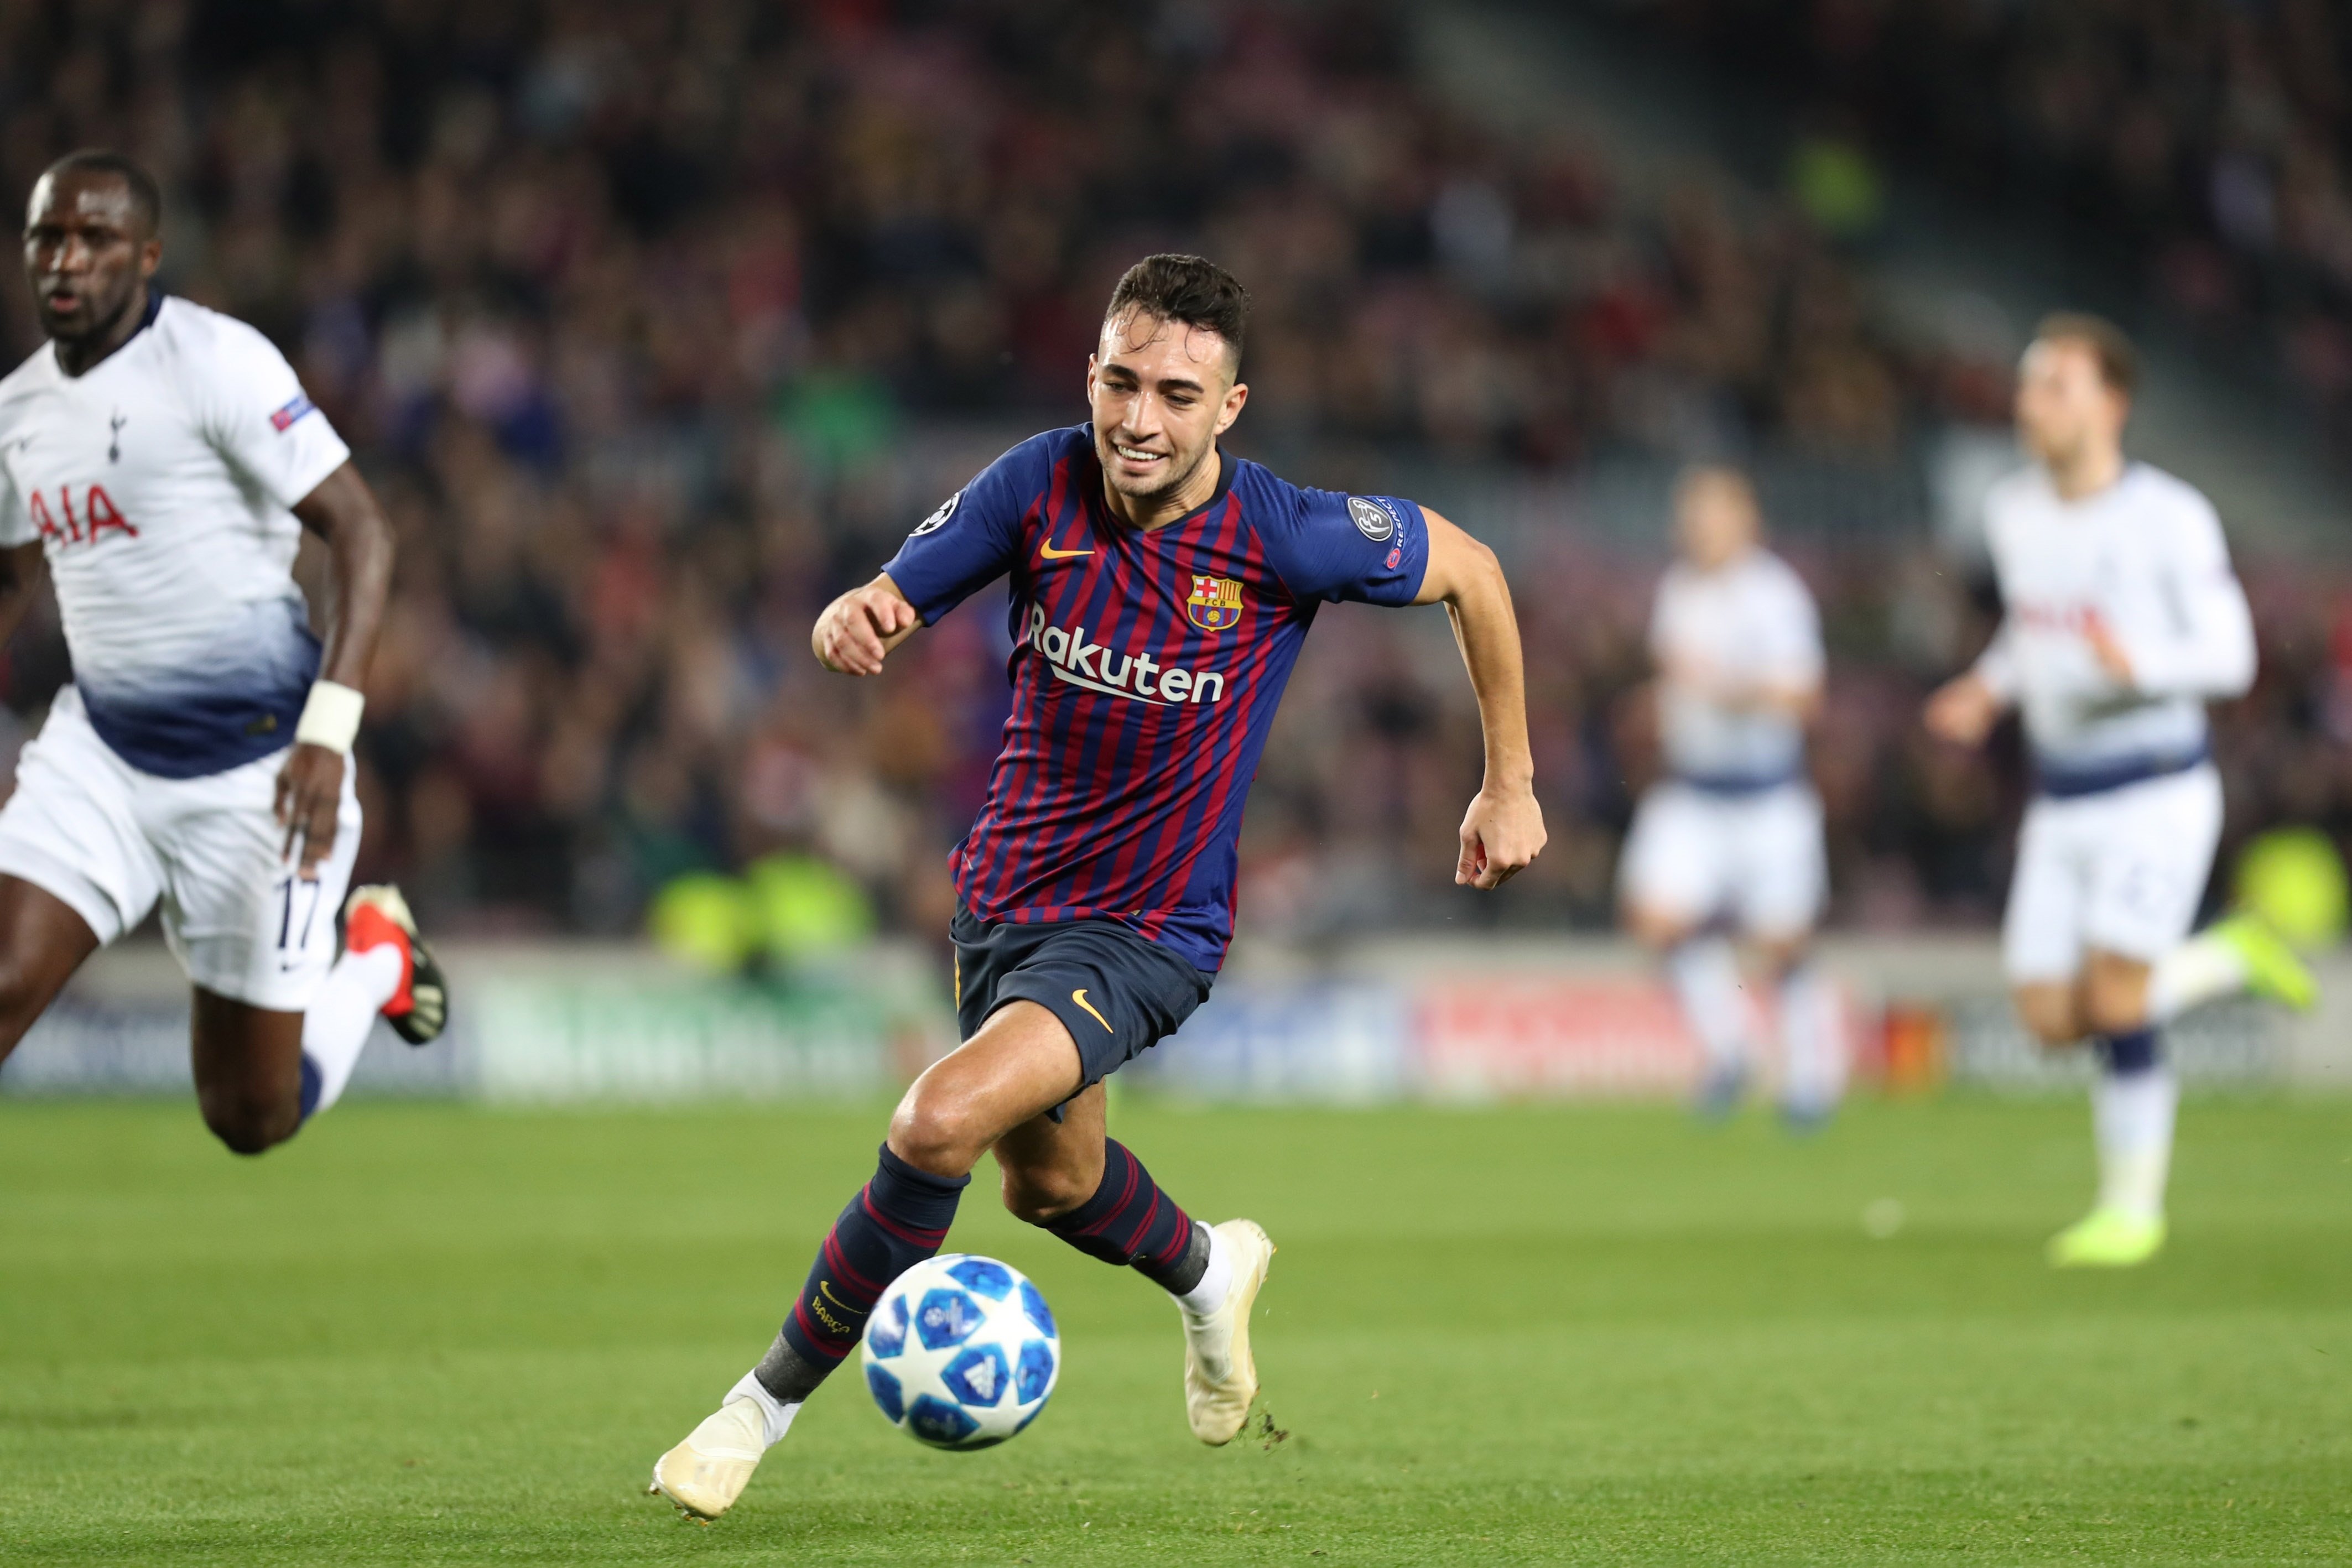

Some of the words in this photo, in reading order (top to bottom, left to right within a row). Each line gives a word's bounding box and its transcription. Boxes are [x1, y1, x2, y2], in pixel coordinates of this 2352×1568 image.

[30, 484, 139, 549] AIA
[1376, 497, 1403, 548] RESPECT
[1027, 600, 1224, 704] Rakuten
[274, 876, 320, 950] 17
